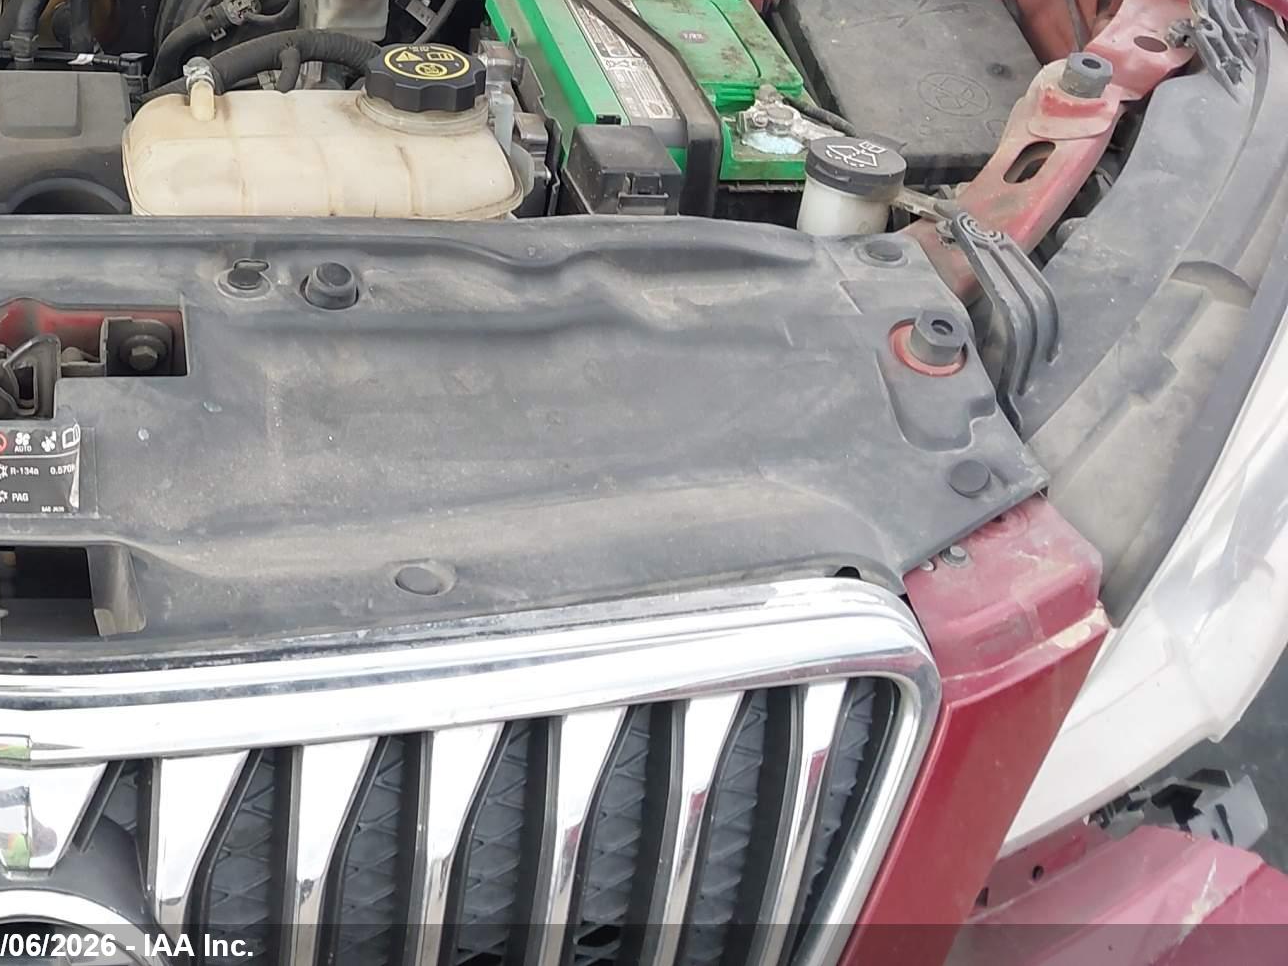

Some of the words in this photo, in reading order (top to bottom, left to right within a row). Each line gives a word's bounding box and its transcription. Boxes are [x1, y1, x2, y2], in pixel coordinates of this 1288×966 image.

[14, 445, 32, 453] AUTO
[10, 465, 39, 476] R-134a
[11, 492, 29, 502] PAG
